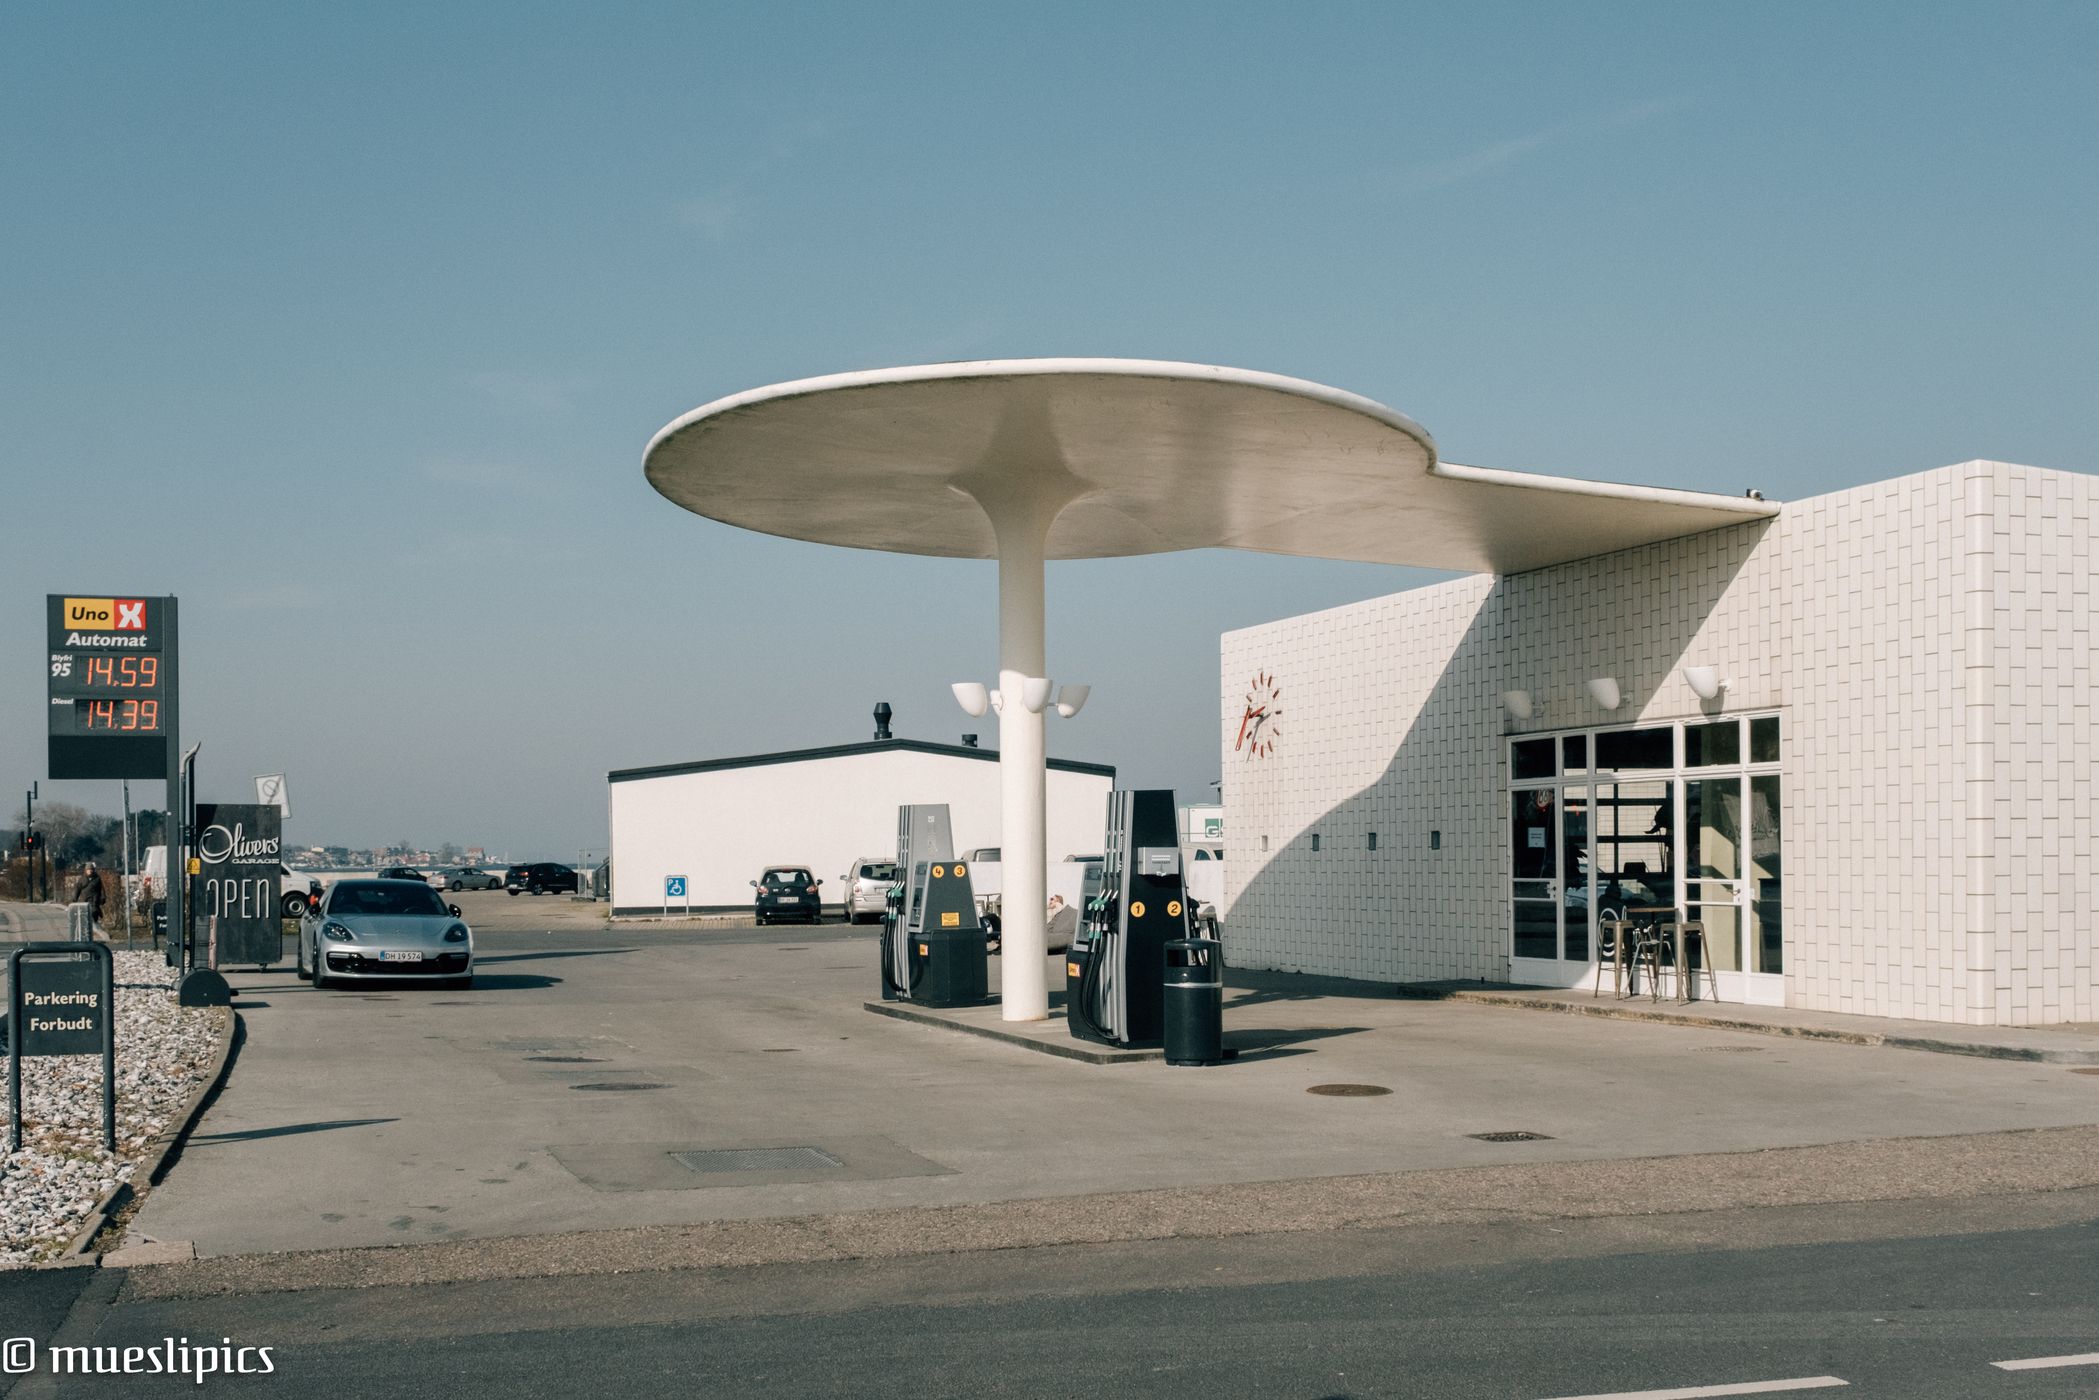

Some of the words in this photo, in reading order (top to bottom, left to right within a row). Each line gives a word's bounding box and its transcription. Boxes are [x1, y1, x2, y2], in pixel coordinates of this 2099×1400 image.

[72, 607, 109, 621] Uno
[118, 603, 143, 628] X
[65, 632, 147, 647] Automat
[51, 654, 72, 663] Blyfri
[51, 663, 72, 677] 95
[200, 822, 279, 864] Olivers
[24, 991, 98, 1008] Parkering
[30, 1017, 93, 1031] Forbudt
